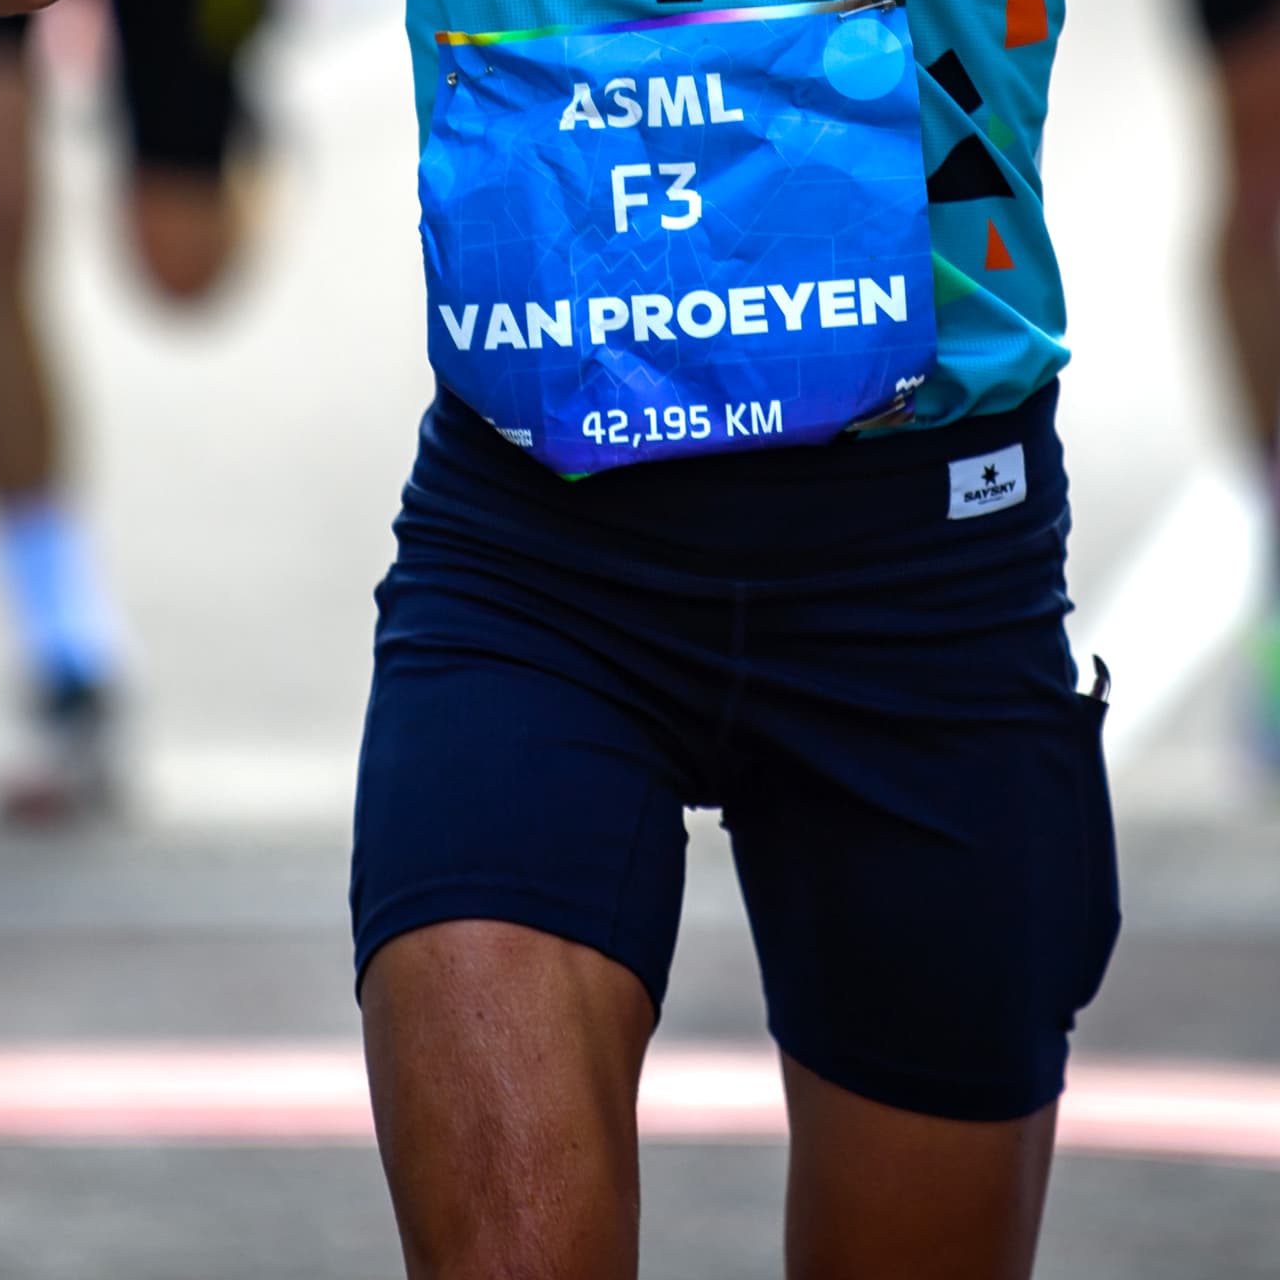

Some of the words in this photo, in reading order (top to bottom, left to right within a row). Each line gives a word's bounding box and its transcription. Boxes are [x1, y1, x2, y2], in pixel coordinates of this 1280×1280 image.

[558, 73, 745, 131] ASML
[611, 162, 703, 234] F3
[438, 298, 574, 351] VAN
[588, 274, 908, 346] PROEYEN
[581, 404, 712, 448] 42,195
[724, 399, 784, 438] KM
[963, 480, 1017, 503] SAYSKY
